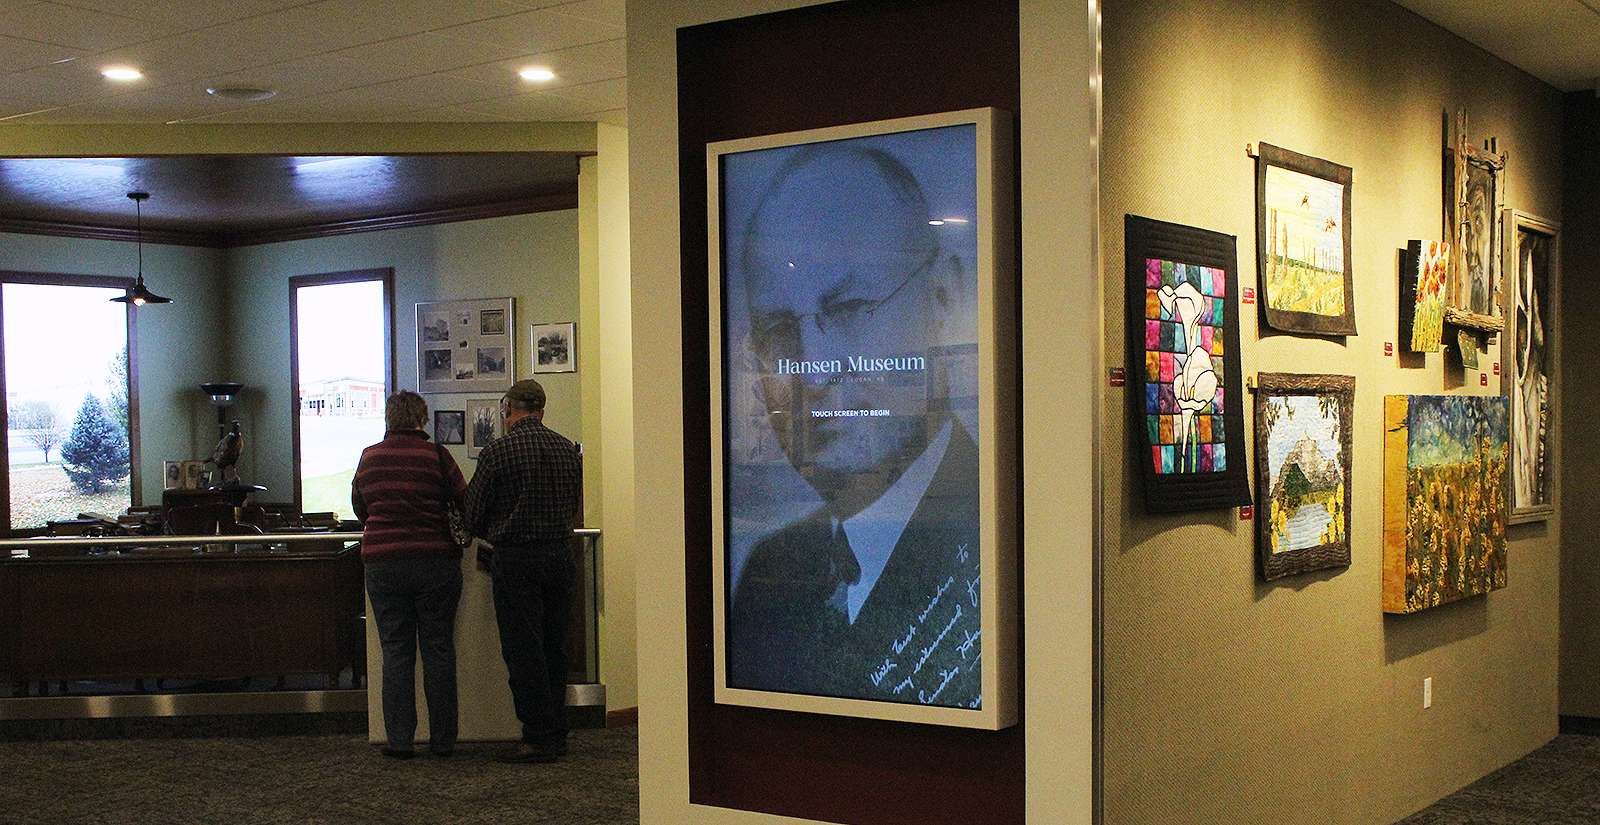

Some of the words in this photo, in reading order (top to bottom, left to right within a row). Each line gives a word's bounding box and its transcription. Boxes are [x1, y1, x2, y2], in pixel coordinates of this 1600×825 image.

[777, 358, 842, 374] Hansen
[847, 355, 925, 372] Museum
[811, 410, 833, 418] TOUCH
[834, 409, 859, 417] SCREEN
[860, 409, 869, 417] TO
[870, 409, 890, 417] BEGIN
